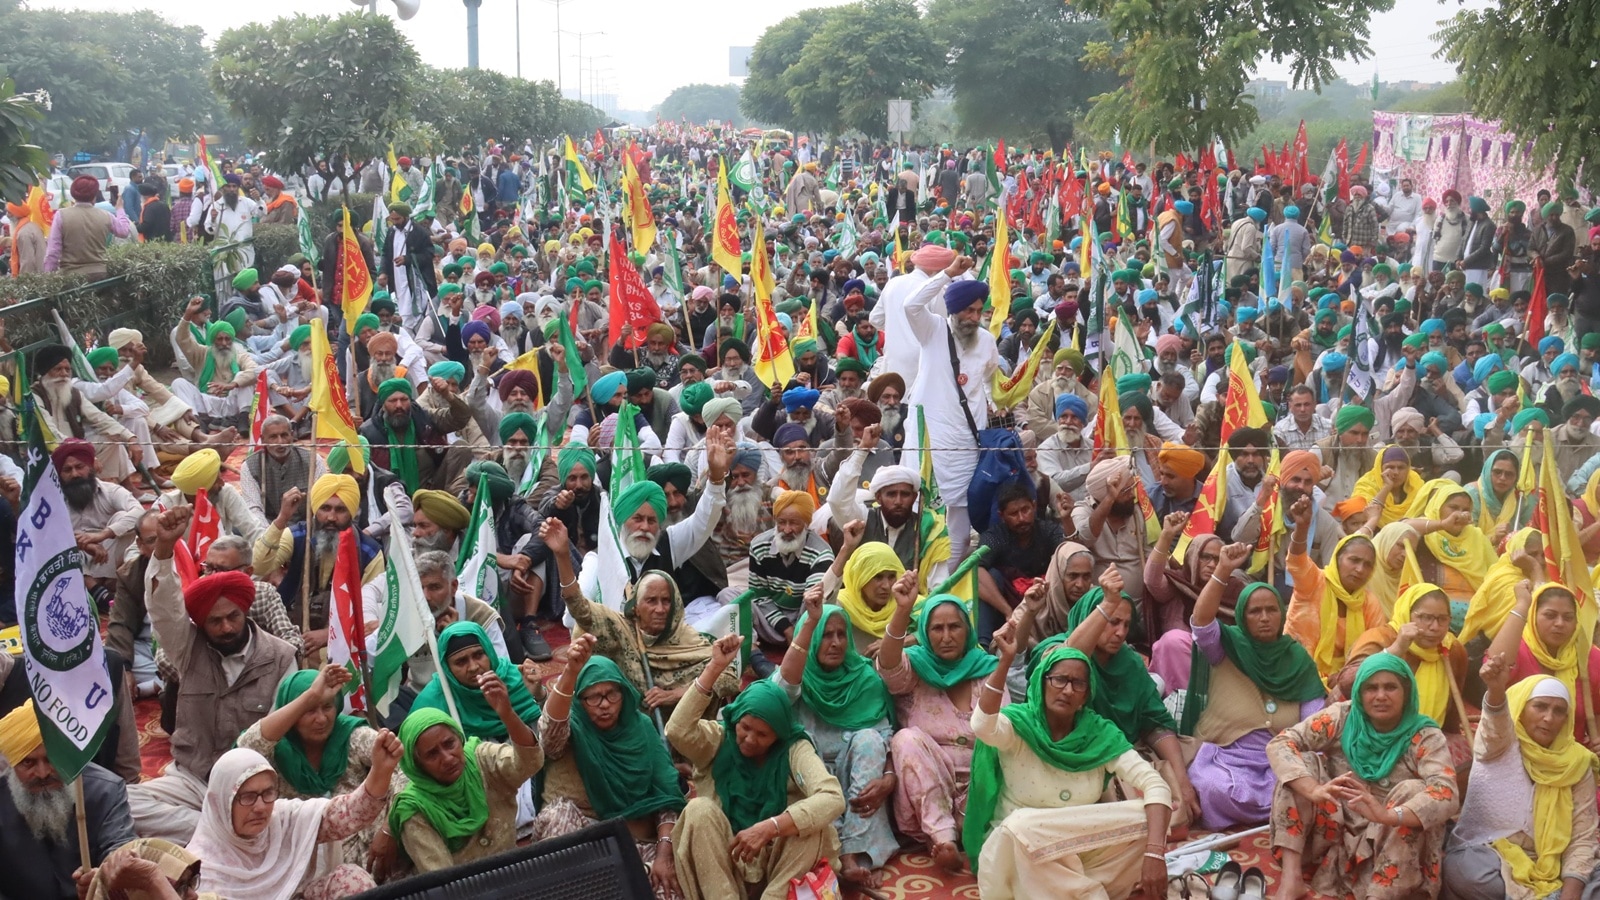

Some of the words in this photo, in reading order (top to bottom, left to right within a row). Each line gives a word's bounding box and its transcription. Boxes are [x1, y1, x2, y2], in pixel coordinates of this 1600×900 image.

[623, 271, 646, 289] ISAN
[31, 496, 52, 530] B
[16, 529, 33, 563] K
[31, 671, 52, 703] NO
[47, 697, 88, 742] FOOD
[85, 681, 107, 709] U
